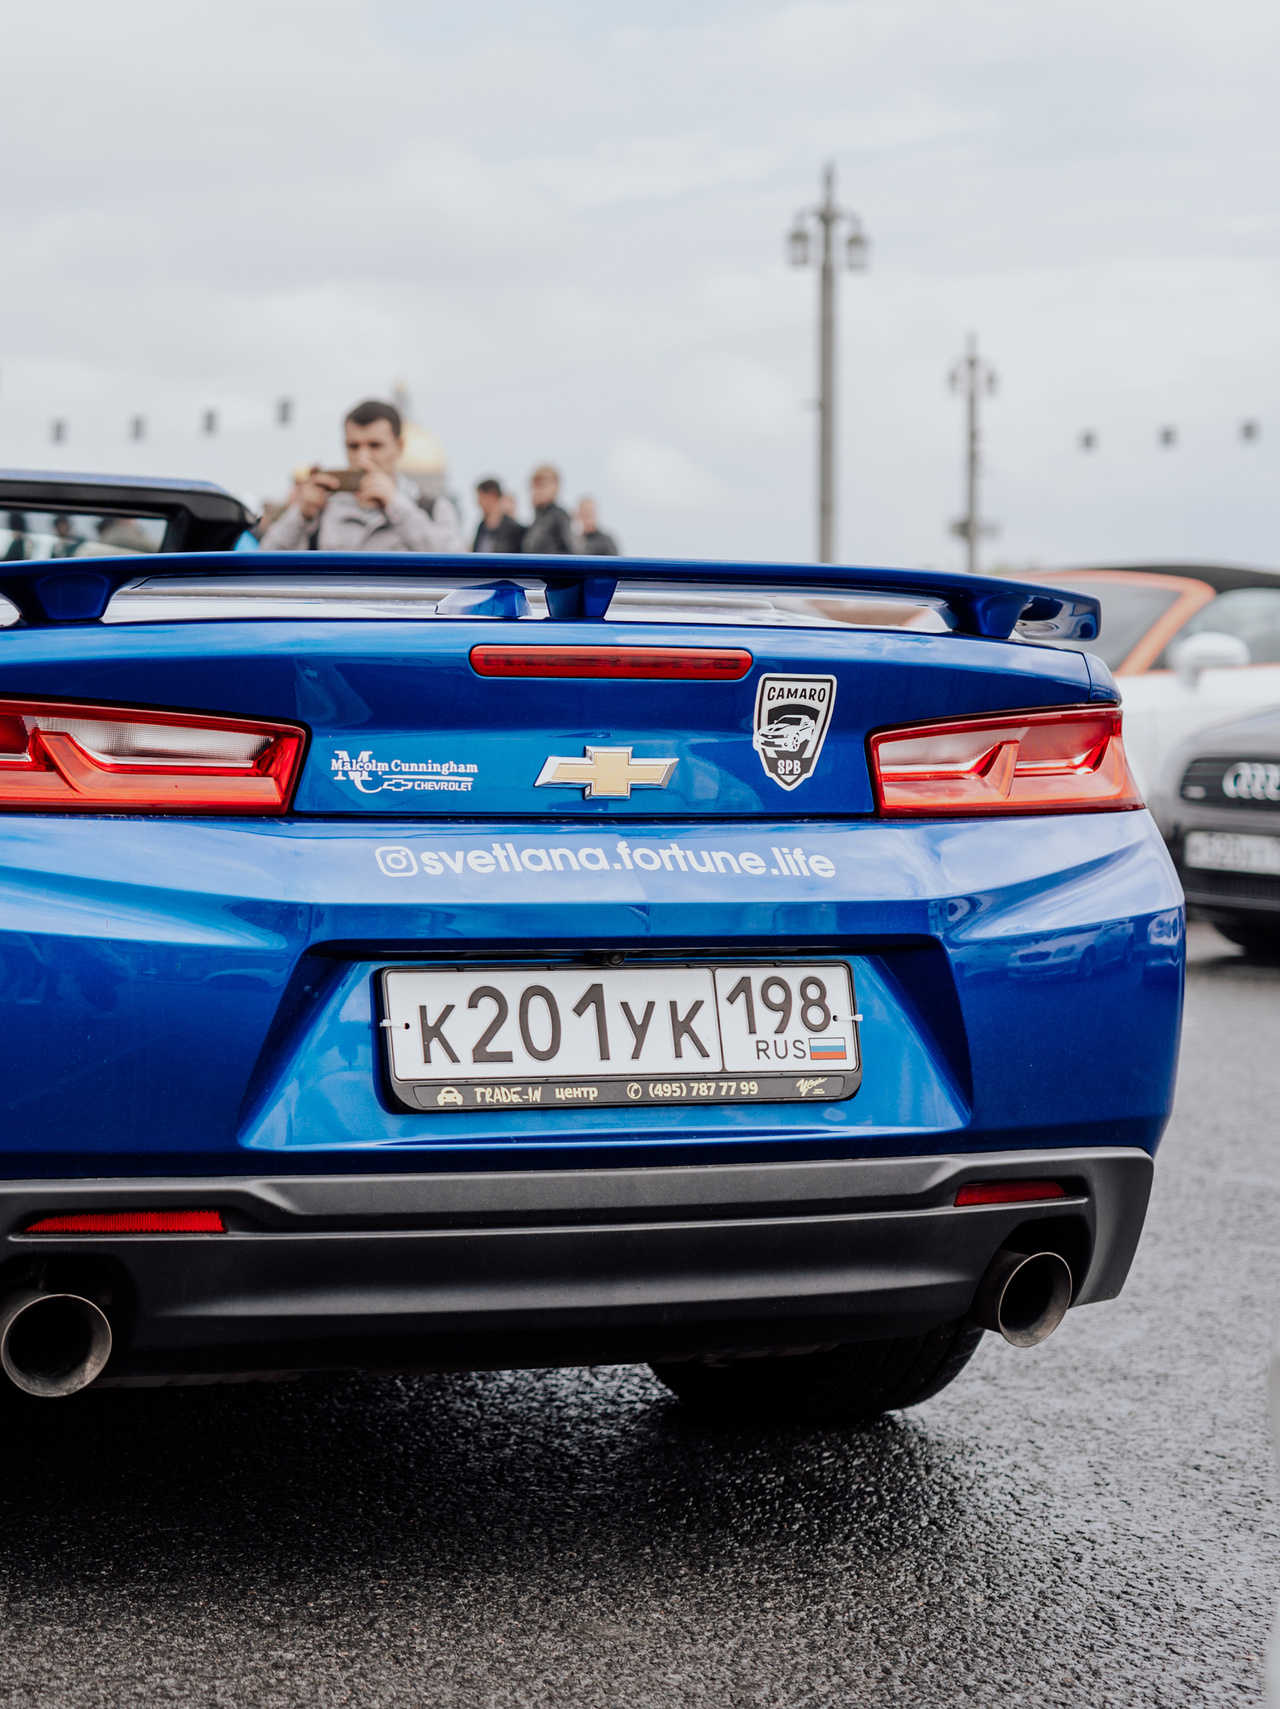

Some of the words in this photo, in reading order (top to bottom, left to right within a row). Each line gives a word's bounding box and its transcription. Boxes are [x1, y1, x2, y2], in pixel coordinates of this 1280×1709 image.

[767, 686, 827, 703] CAMARO
[330, 758, 390, 772] Malcolm
[391, 759, 479, 775] Cunningham
[777, 759, 802, 775] SPB
[414, 780, 473, 792] CHEVROLET
[422, 840, 837, 879] svetlana.fortune.life
[725, 975, 832, 1035] 198
[755, 1039, 807, 1061] RUS
[473, 1086, 542, 1104] TRADE-IN
[554, 1085, 599, 1101] центр
[647, 1082, 688, 1098] (495)
[689, 1082, 717, 1097] 787
[718, 1081, 737, 1096] 77
[739, 1080, 759, 1096] 99
